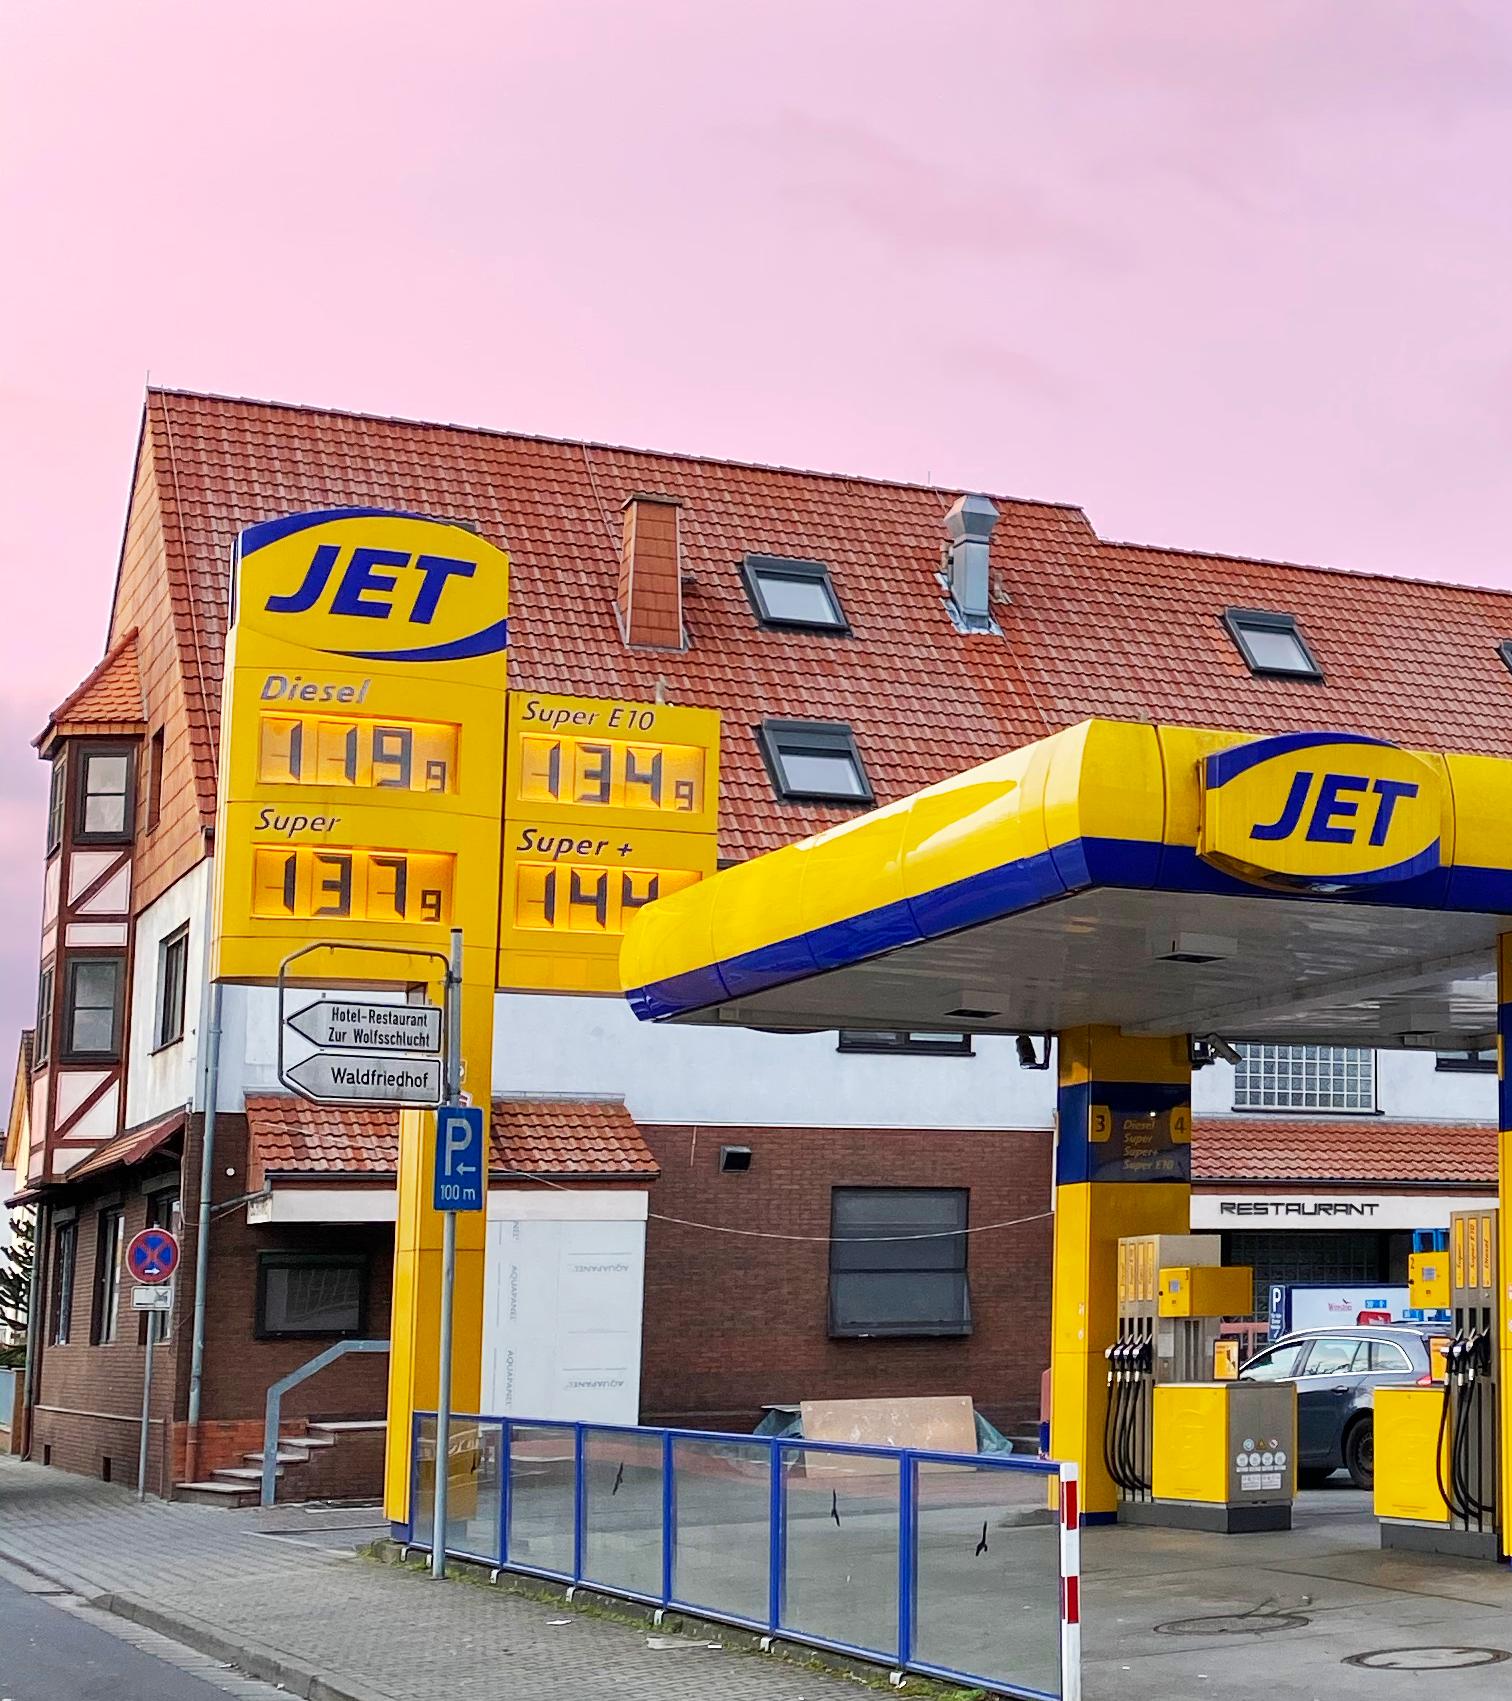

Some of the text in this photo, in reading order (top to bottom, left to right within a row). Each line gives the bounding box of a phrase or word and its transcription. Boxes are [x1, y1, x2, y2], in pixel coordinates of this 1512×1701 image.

[264, 545, 477, 624] JET
[260, 675, 371, 704] Diesel
[521, 701, 655, 731] Super E10
[1250, 771, 1419, 847] JET
[255, 809, 341, 836] Super
[517, 829, 607, 859] Super
[331, 1006, 428, 1027] Hotel-Restaurant
[328, 1027, 430, 1048] Zur Wolfsschlucht
[331, 1067, 428, 1088] Waldfriedhof
[1095, 1115, 1105, 1132] 3
[1123, 1120, 1156, 1130] Diesel
[1174, 1116, 1187, 1133] 4
[444, 1118, 473, 1176] P
[1123, 1133, 1153, 1145] Super
[1123, 1160, 1153, 1171] Super
[440, 1184, 476, 1200] 100 m
[1220, 1202, 1379, 1216] RESTAURANT
[1272, 1287, 1281, 1313] P
